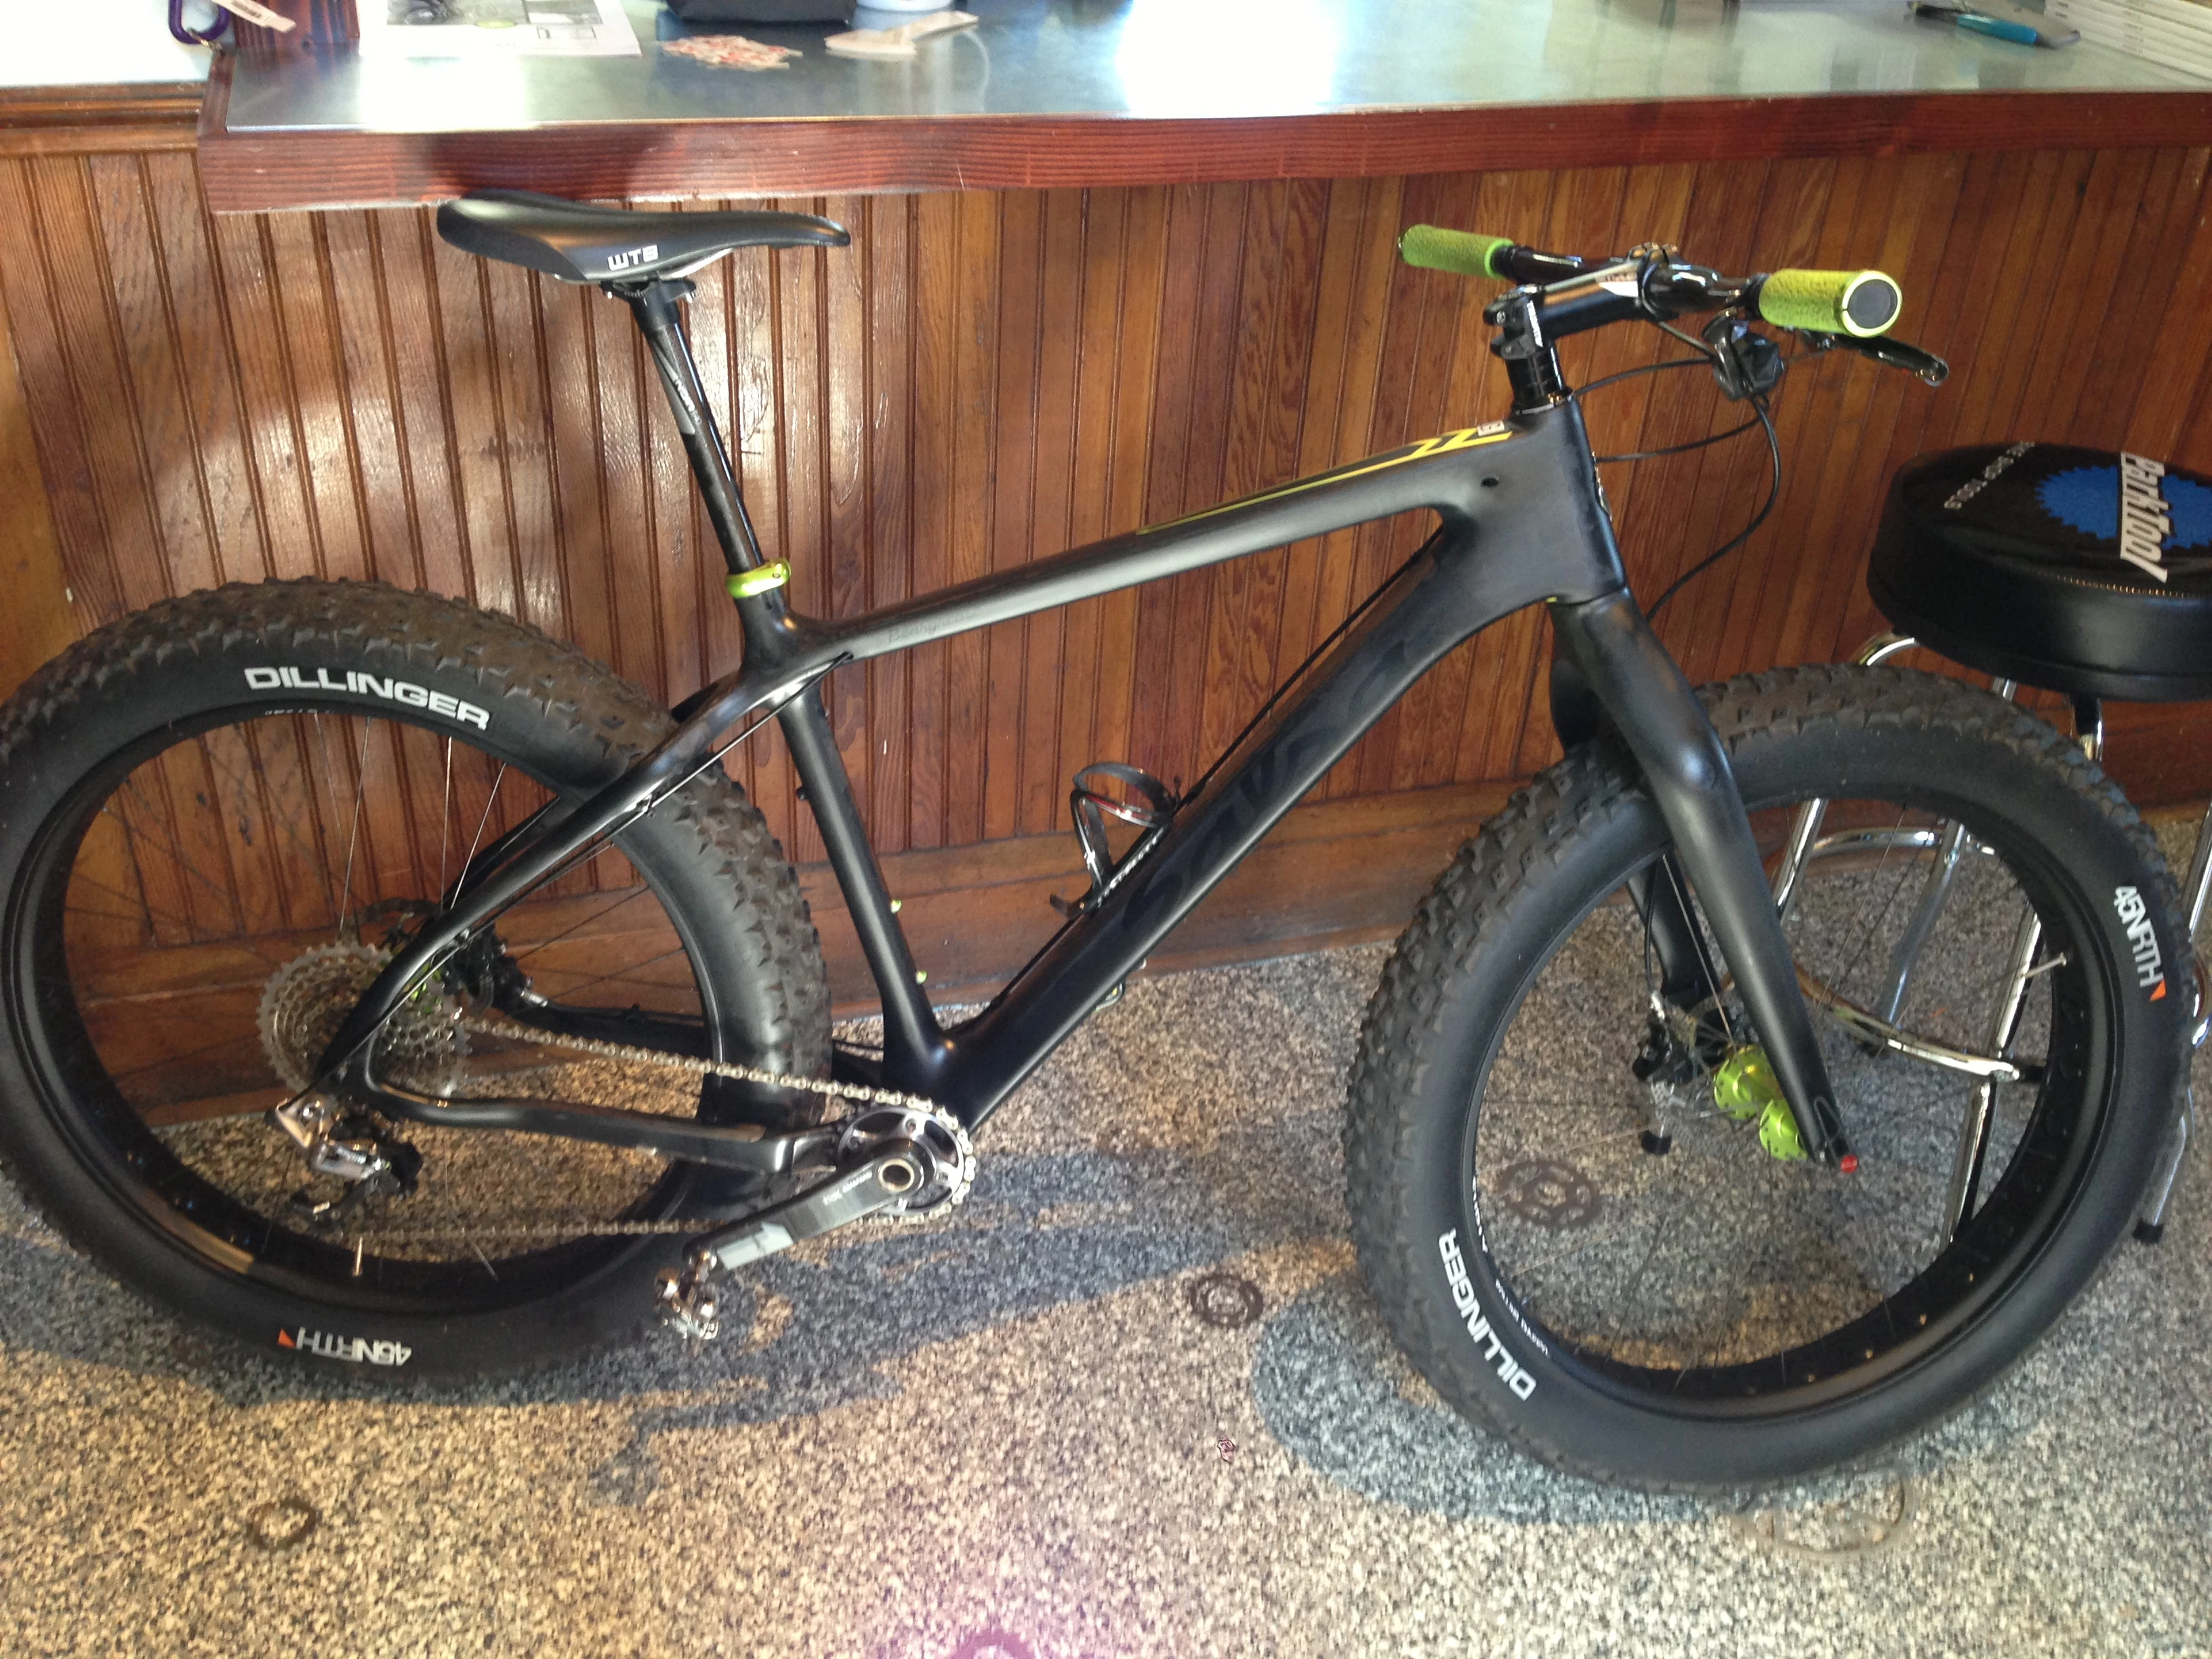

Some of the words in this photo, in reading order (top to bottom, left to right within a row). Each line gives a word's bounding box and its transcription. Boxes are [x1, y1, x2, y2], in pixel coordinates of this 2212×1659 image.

[607, 244, 659, 271] WTB
[243, 665, 491, 731] DILLINGER
[1438, 1227, 1537, 1401] DILLINGER
